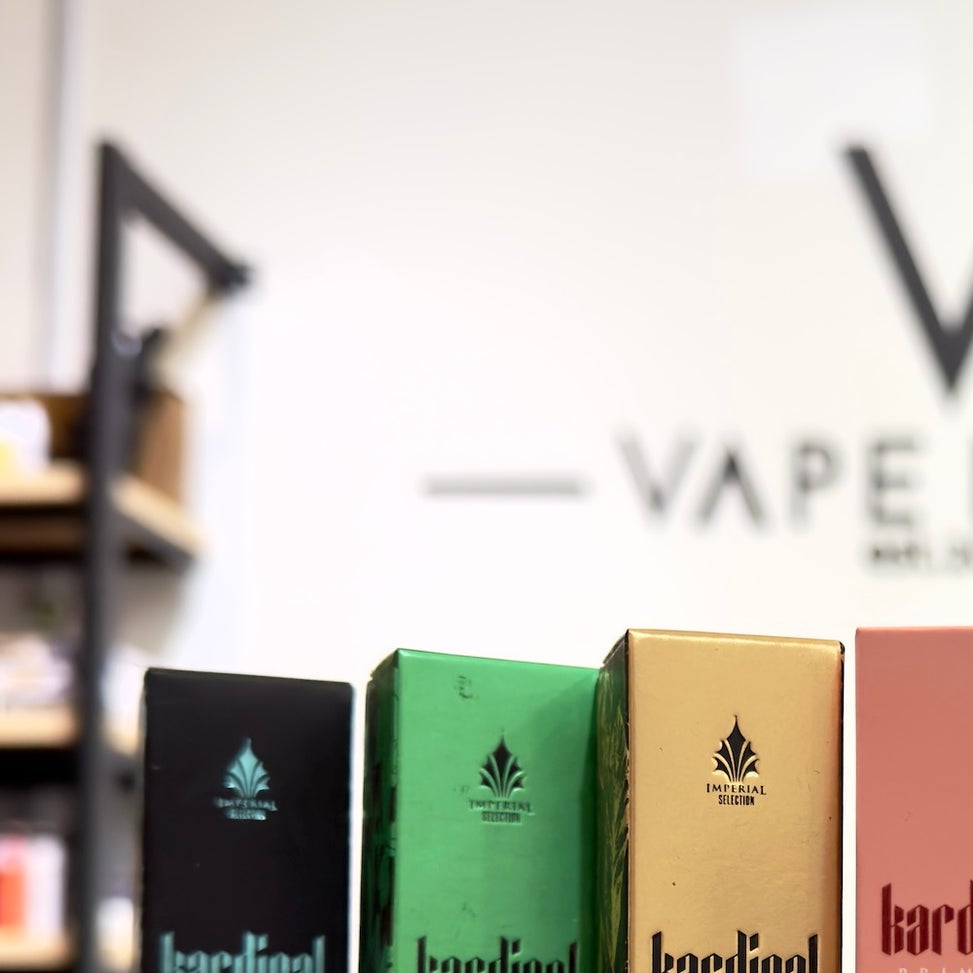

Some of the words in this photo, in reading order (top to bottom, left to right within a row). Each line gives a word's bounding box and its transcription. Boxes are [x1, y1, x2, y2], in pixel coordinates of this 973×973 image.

[616, 432, 922, 531] VAPE
[707, 783, 767, 795] IMPERIAL
[718, 795, 755, 806] SELECTION
